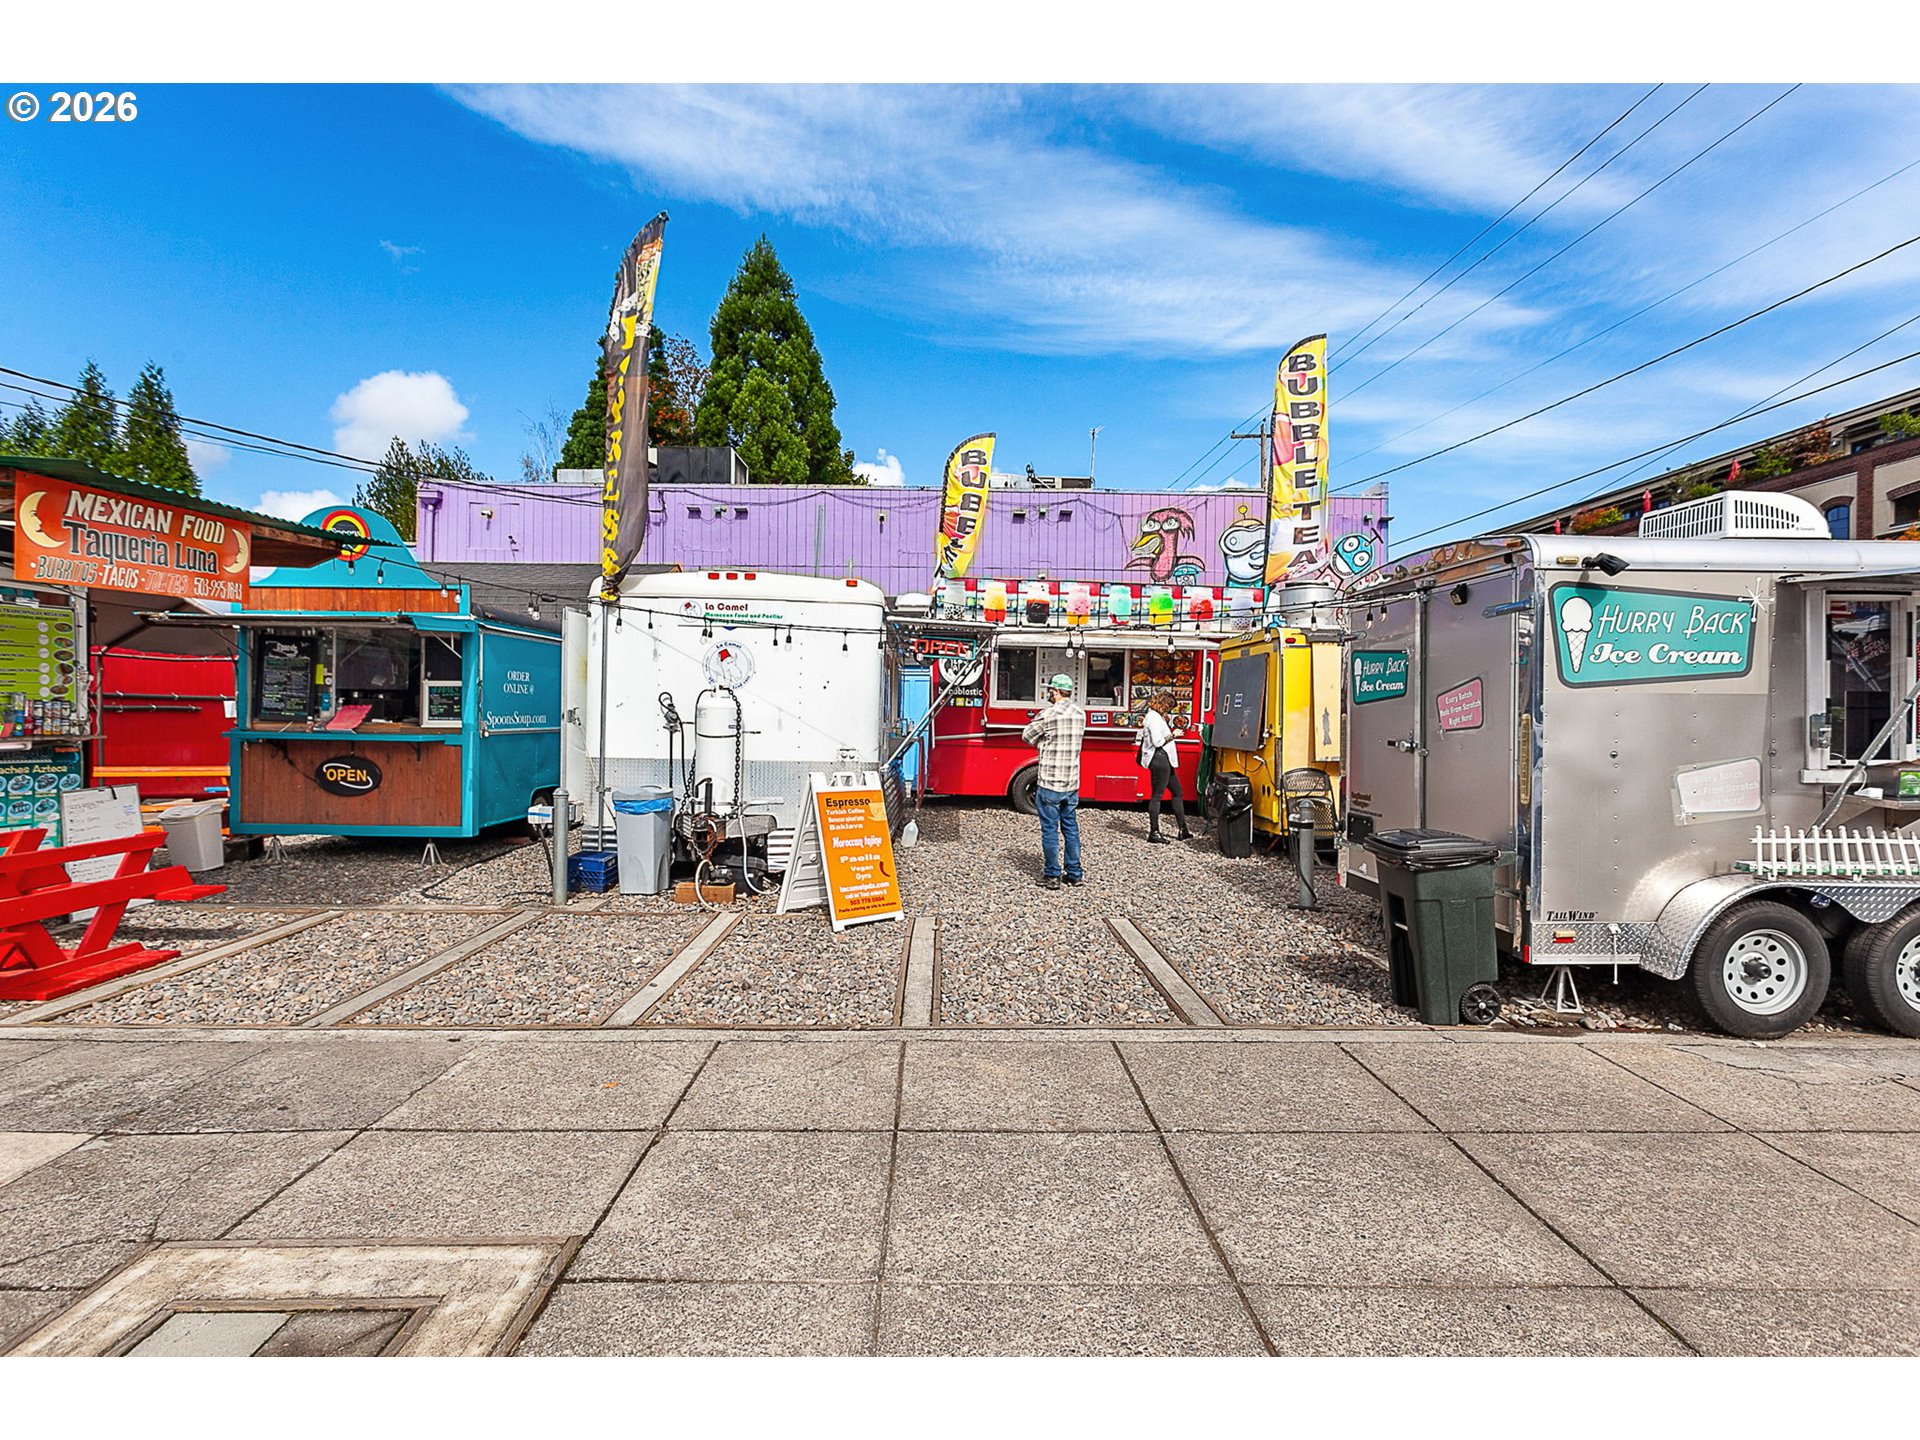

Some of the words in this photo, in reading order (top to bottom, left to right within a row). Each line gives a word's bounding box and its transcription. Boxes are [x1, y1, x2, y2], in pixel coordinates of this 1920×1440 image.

[1287, 353, 1321, 489] BUBBLE
[65, 490, 173, 534] MEXICAN
[180, 514, 225, 544] FOOD
[1287, 499, 1320, 569] TEA
[62, 518, 169, 567] Taqueria
[174, 541, 220, 575] Luna
[34, 556, 97, 583] BURRITOS
[102, 564, 139, 589] TACOS
[717, 602, 748, 612] Camel
[1597, 604, 1675, 639] HURRY
[1682, 605, 1748, 639] BACK
[1589, 642, 1642, 664] Ice
[1649, 643, 1743, 664] Cream
[1362, 660, 1385, 678] HURRY
[1386, 657, 1406, 676] BACK
[507, 670, 530, 681] ORDER
[503, 683, 529, 694] ONLINE
[1360, 681, 1374, 692] Ice
[1375, 680, 1405, 691] Cream
[487, 711, 547, 728] SpoonsSoup.com
[33, 764, 68, 773] Azteca
[326, 768, 367, 781] OPEN
[825, 798, 871, 809] Espresso
[829, 823, 864, 831] Baklava
[840, 853, 880, 863] Paella
[855, 873, 872, 881] Gyro
